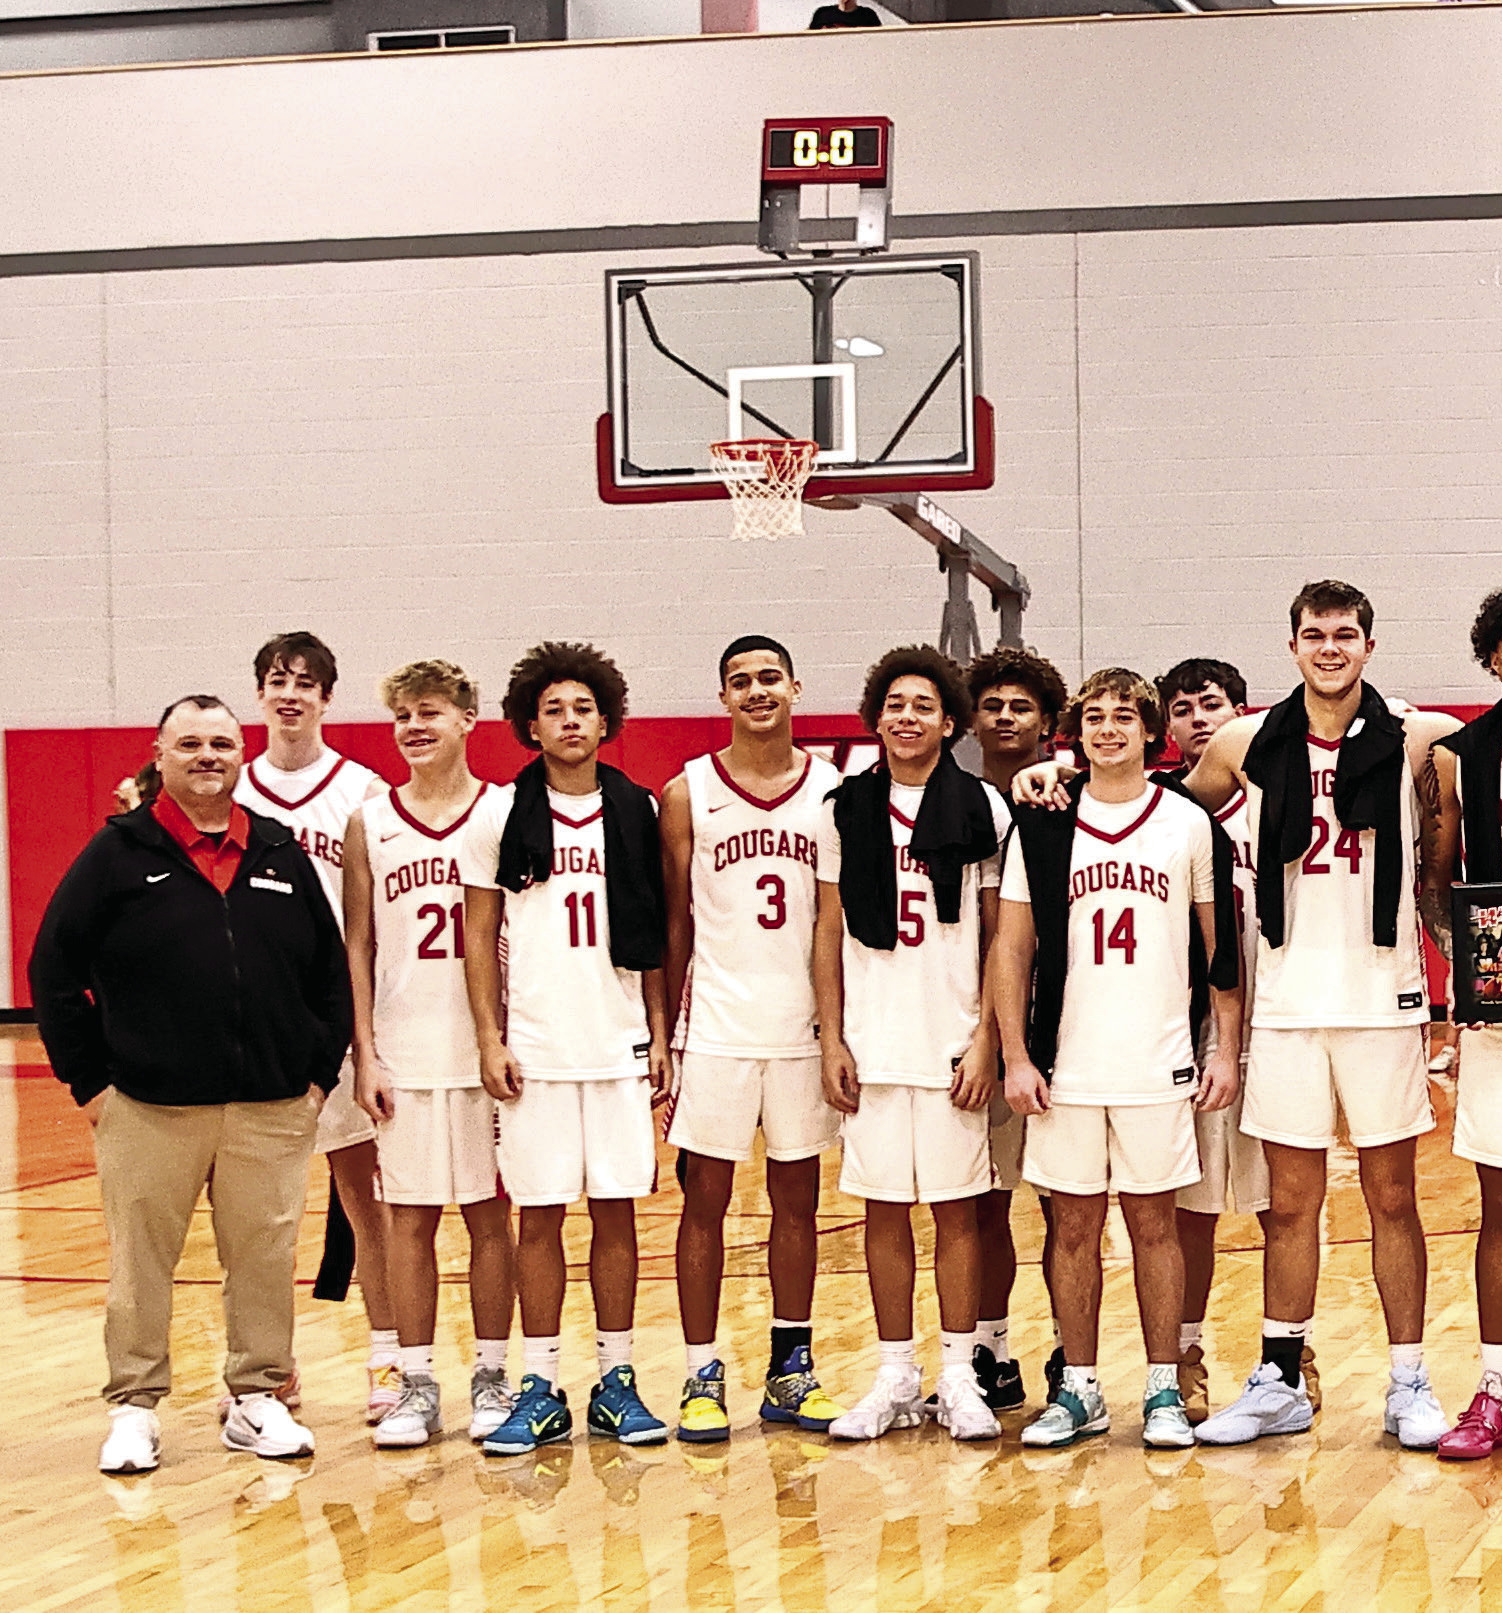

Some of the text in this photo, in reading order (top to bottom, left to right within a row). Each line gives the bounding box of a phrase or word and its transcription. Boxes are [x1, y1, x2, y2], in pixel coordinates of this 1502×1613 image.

[793, 130, 854, 168] 0.0
[714, 828, 818, 872] COUGARS
[1302, 816, 1363, 875] 24
[564, 891, 597, 948] 11
[756, 873, 787, 930] 3
[416, 901, 466, 960] 21
[1092, 907, 1138, 965] 14
